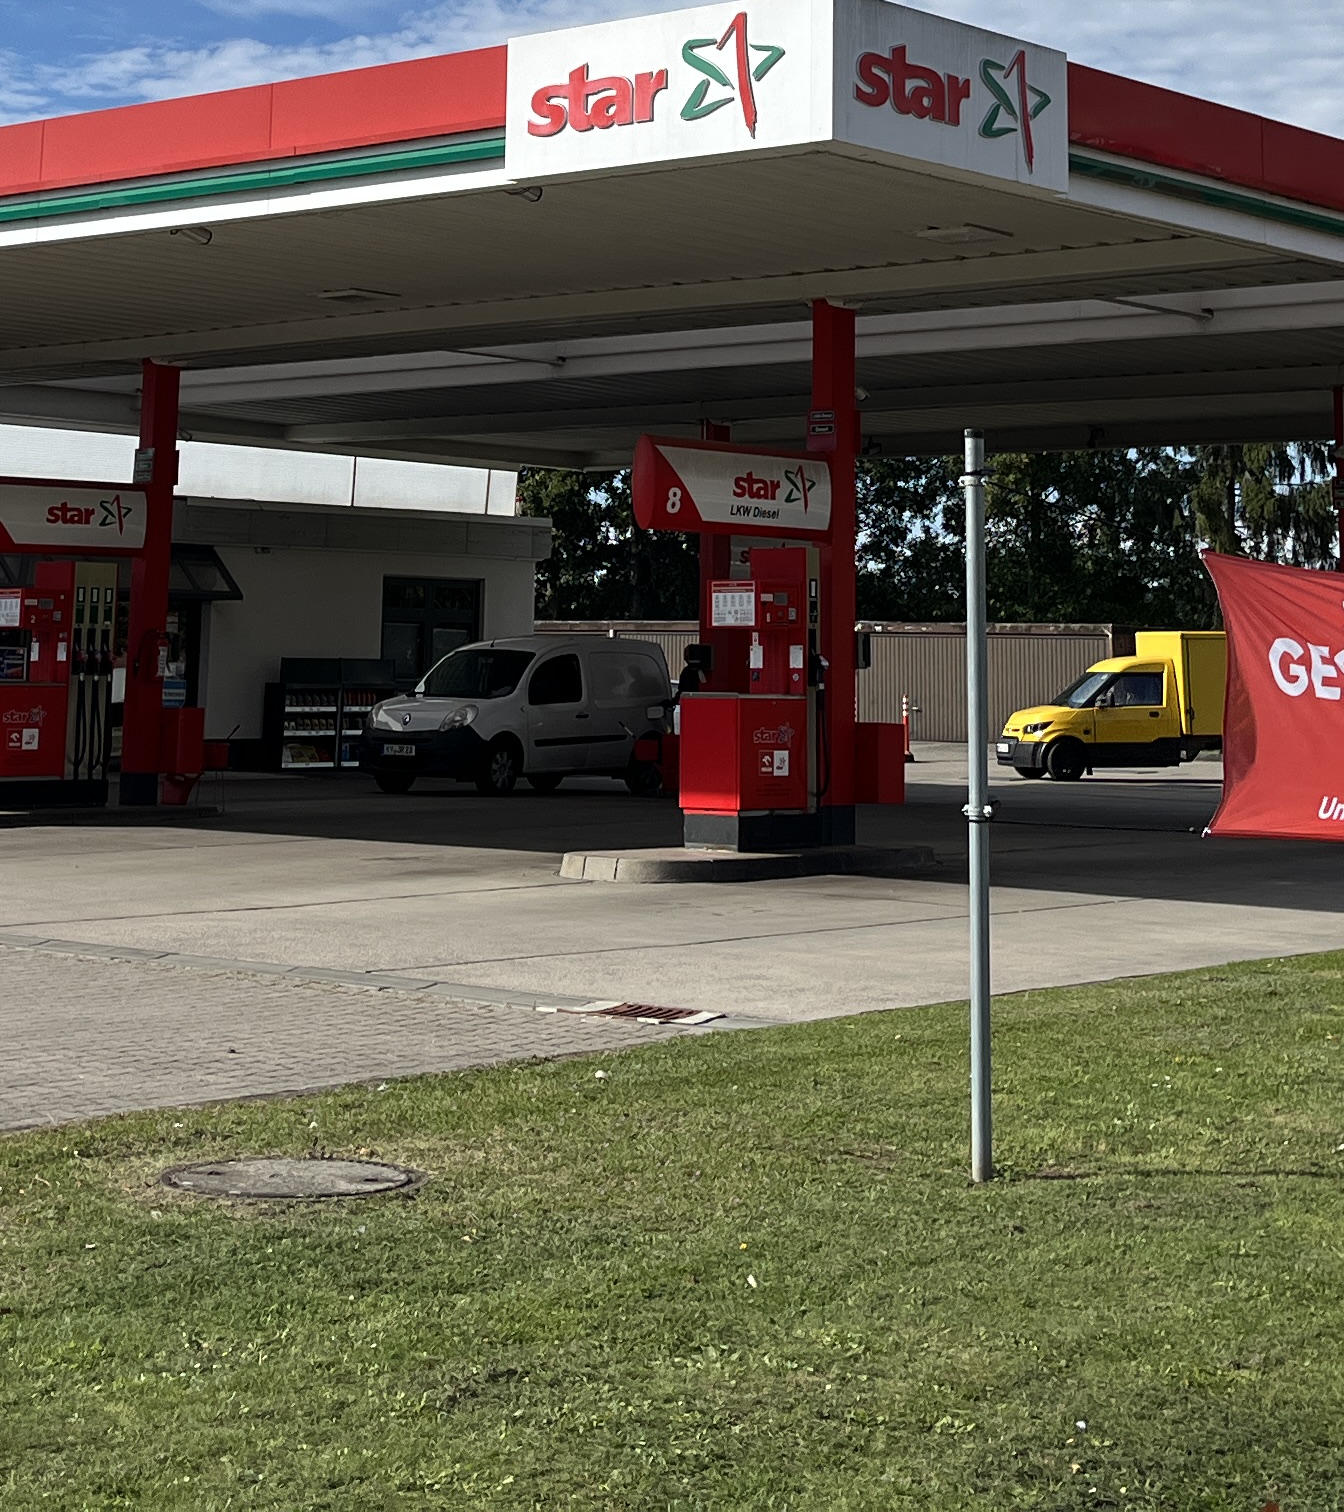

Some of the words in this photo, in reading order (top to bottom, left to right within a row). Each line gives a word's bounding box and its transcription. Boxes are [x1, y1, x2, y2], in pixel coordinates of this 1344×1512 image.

[853, 44, 970, 126] star
[527, 62, 668, 137] star
[732, 471, 780, 500] star
[46, 501, 96, 525] star
[666, 487, 681, 514] 8
[730, 505, 752, 517] LKW
[753, 506, 780, 519] Diesel
[2, 709, 28, 723] star
[753, 727, 778, 743] star
